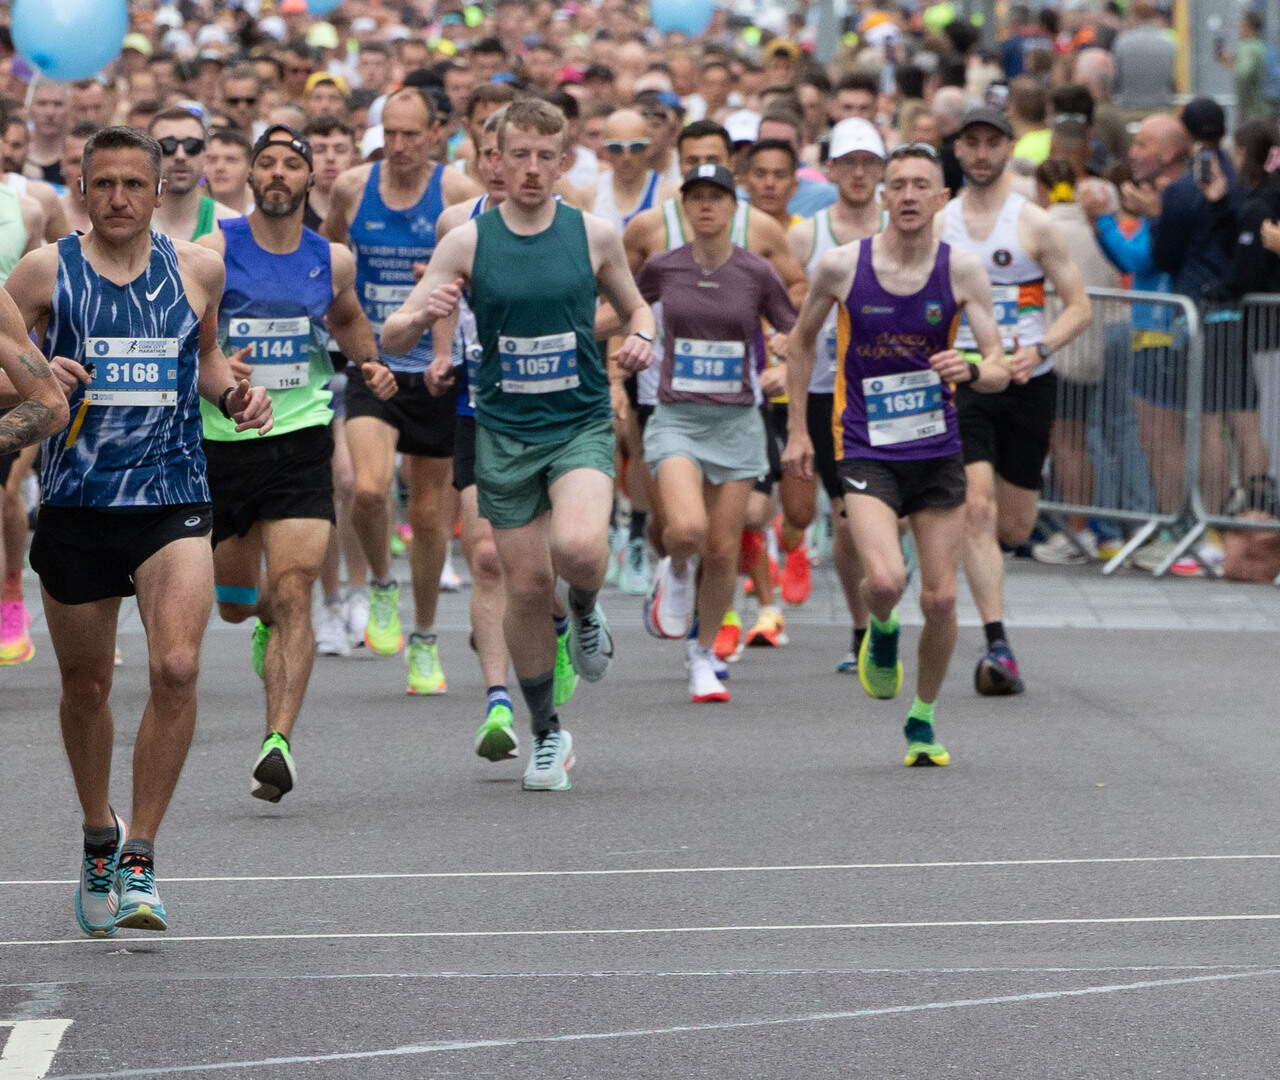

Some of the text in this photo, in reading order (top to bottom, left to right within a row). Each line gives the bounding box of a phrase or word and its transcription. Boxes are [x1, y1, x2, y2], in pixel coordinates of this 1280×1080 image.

[248, 340, 293, 358] 1144
[105, 362, 159, 383] 3168
[516, 356, 561, 375] 1057
[693, 358, 724, 376] 518
[279, 378, 300, 387] 1144
[882, 391, 927, 413] 1637
